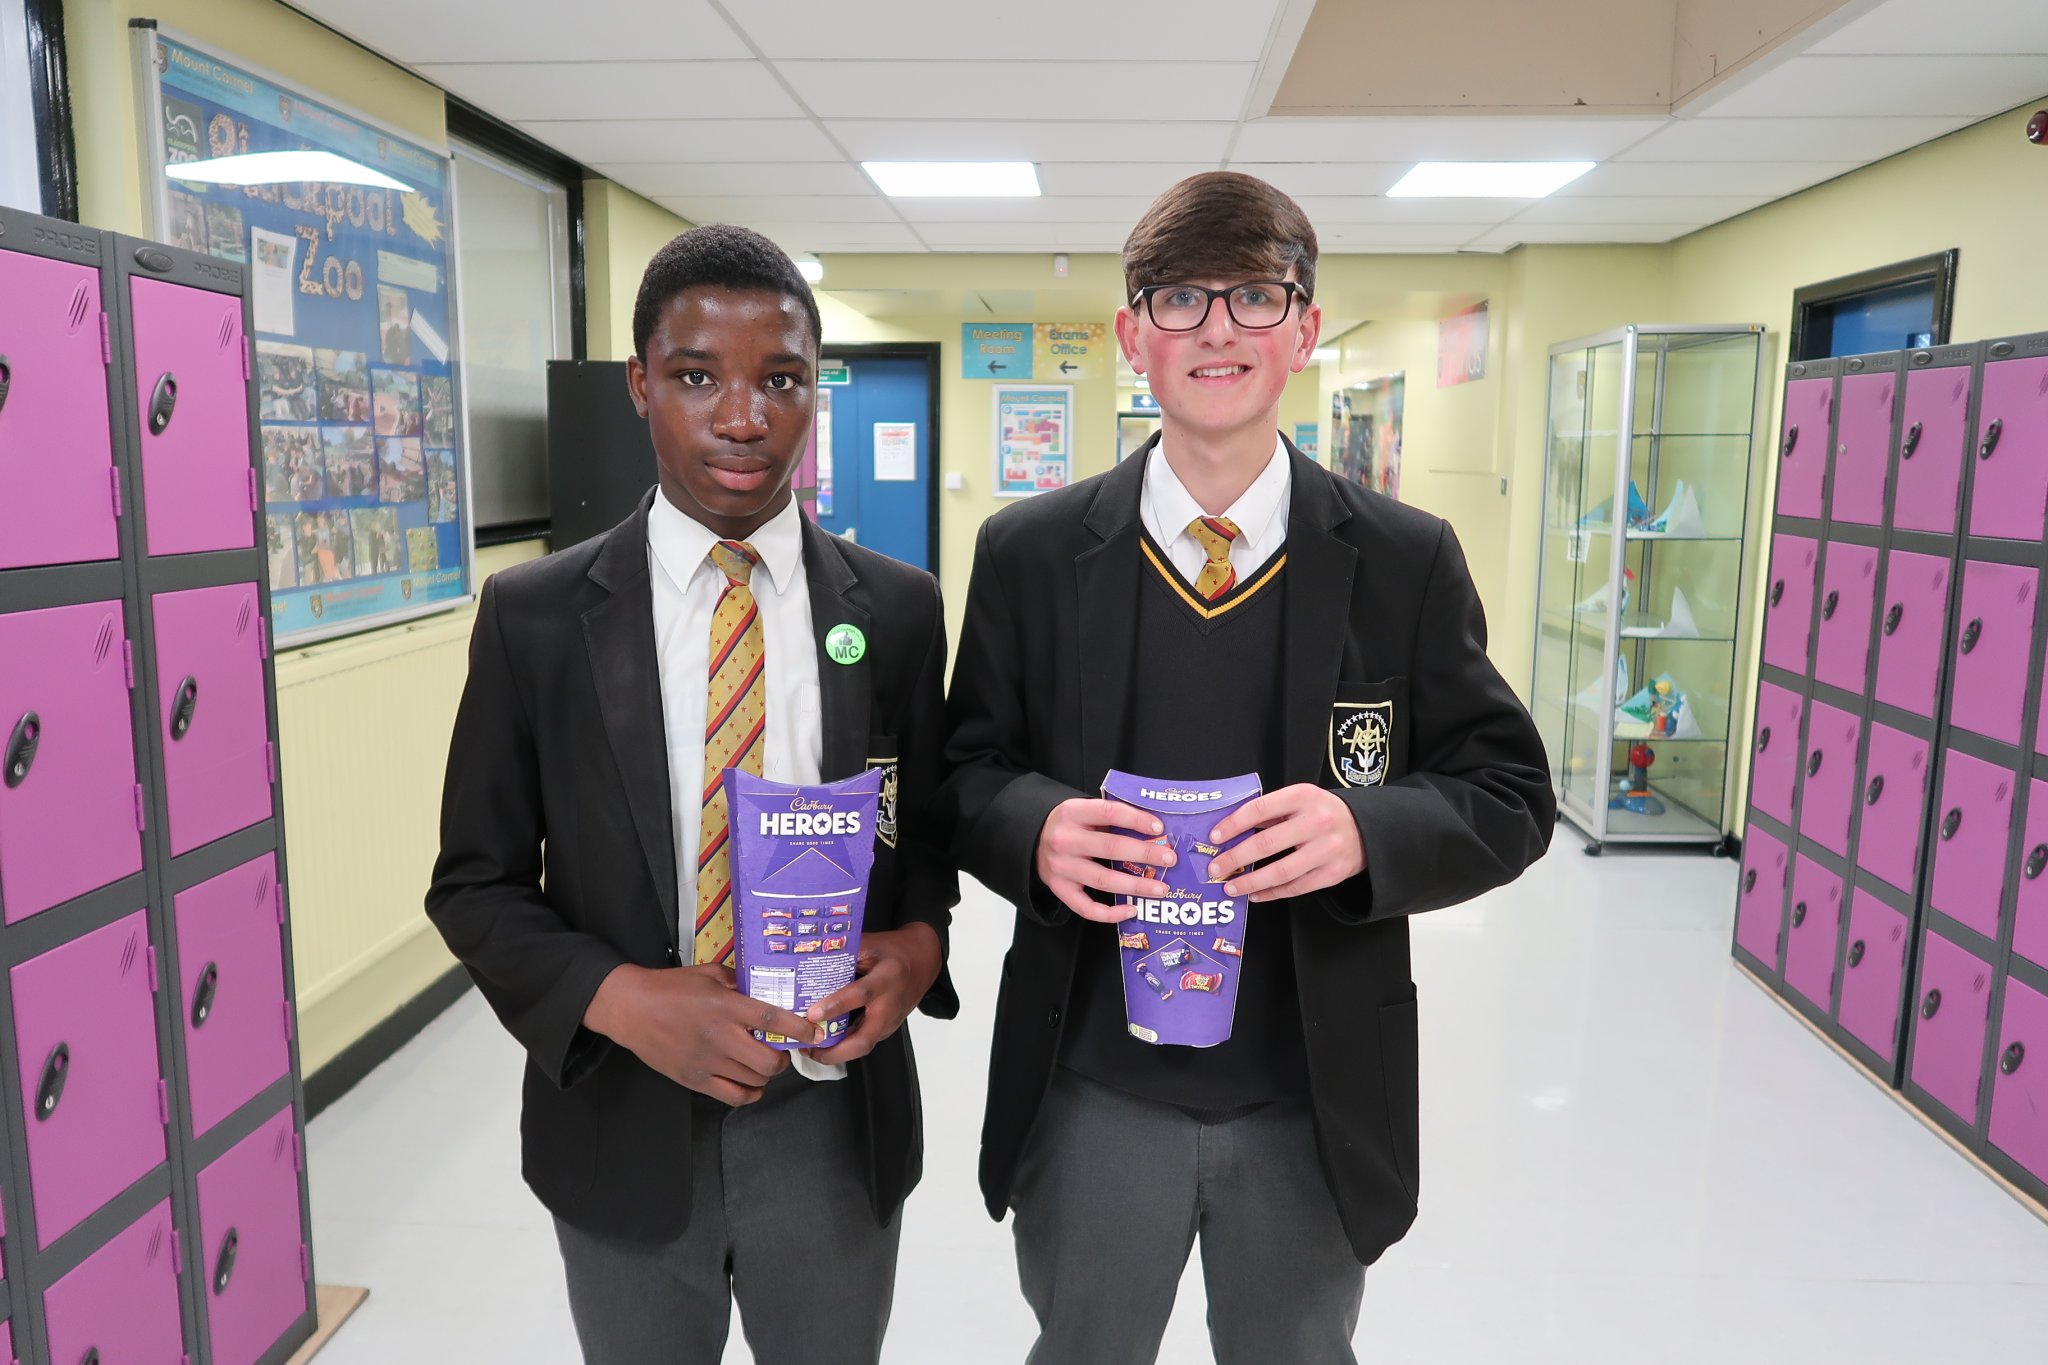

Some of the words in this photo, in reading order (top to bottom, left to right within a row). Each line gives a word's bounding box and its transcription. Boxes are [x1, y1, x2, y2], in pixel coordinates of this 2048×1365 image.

[171, 48, 210, 75] Mount
[213, 65, 254, 93] Carmel
[219, 181, 397, 241] ckpool
[295, 224, 364, 300] Zoo
[973, 329, 1024, 341] Meeting
[1050, 329, 1089, 340] Exams
[1051, 344, 1088, 355] Office
[834, 645, 860, 660] MC
[1140, 787, 1223, 802] HEROES
[789, 797, 833, 813] Cadbury
[760, 811, 861, 836] HEROES
[1166, 887, 1203, 903] adbury
[1126, 895, 1235, 926] HEROES
[1161, 951, 1182, 962] DAIRY
[1164, 958, 1181, 968] MILK
